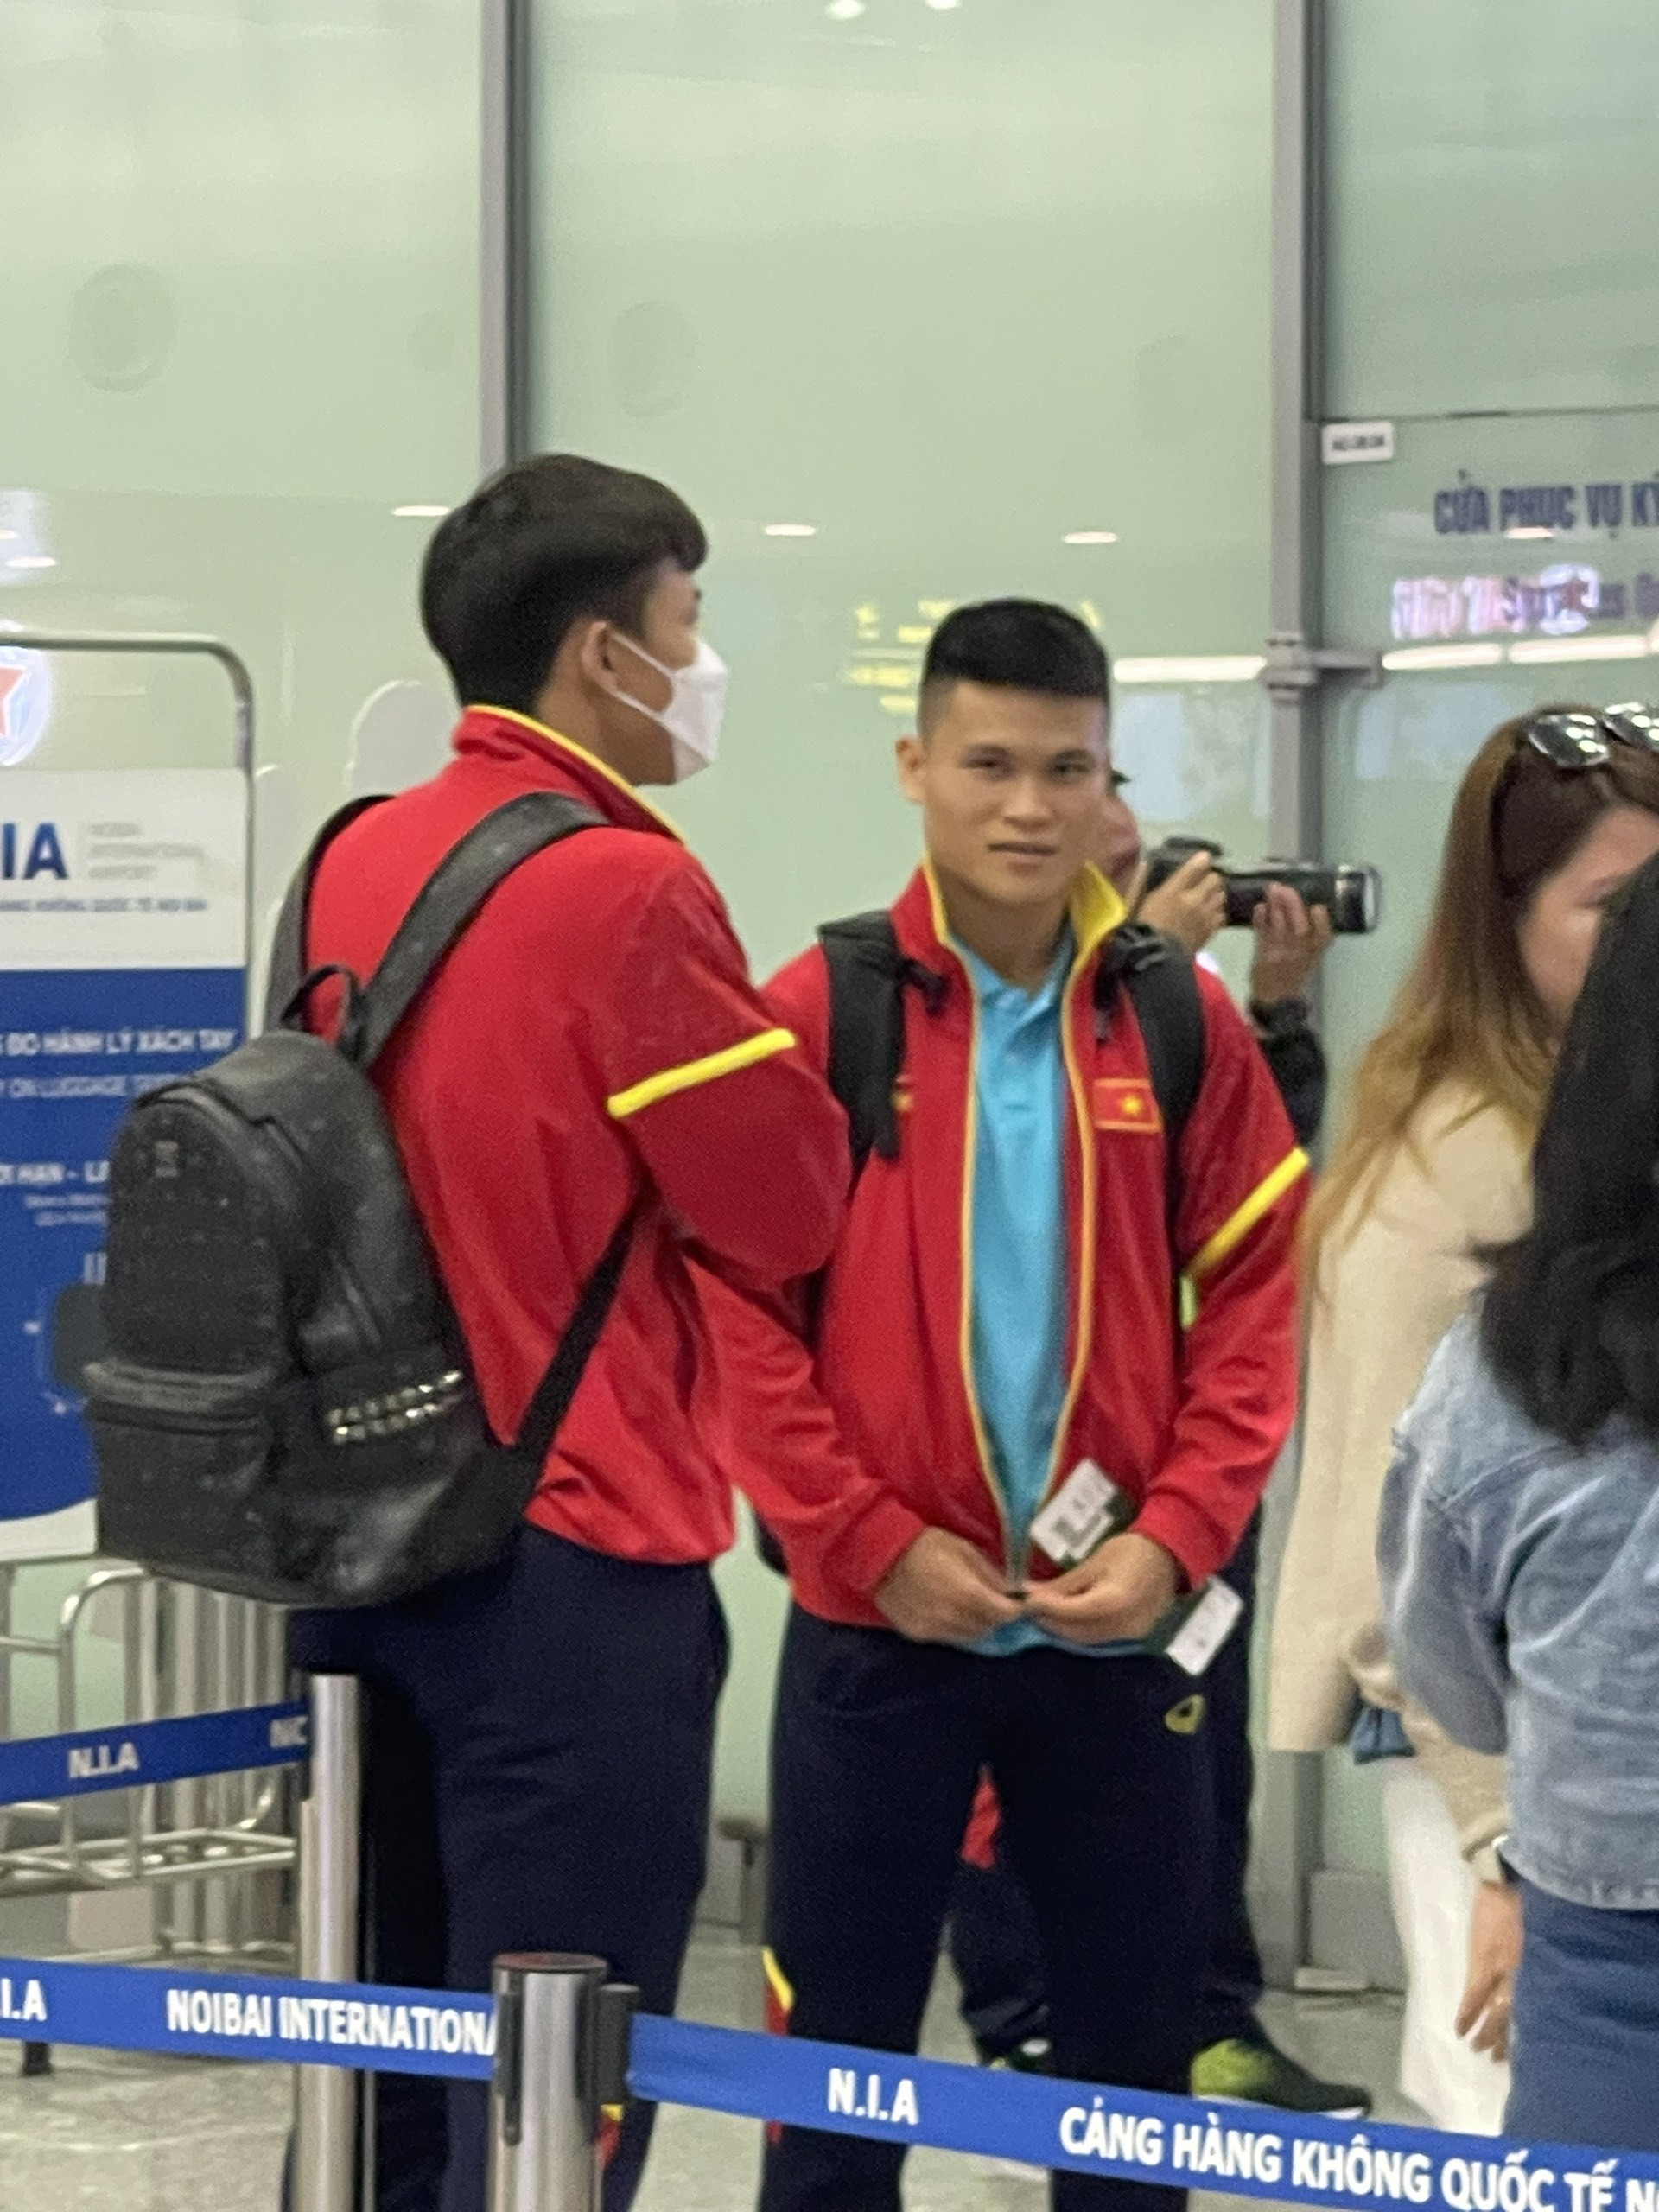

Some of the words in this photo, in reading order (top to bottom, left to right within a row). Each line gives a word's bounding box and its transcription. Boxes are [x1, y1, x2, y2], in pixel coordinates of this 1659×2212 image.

[167, 1989, 272, 2037] NOIBAI
[827, 2068, 918, 2126] N.I.A
[1059, 2095, 1165, 2166] CẢNG
[1173, 2112, 1281, 2183] HÀNG
[1292, 2133, 1432, 2203] KHÔNG
[1441, 2149, 1555, 2212] QUỐC
[1562, 2158, 1619, 2212] TẾ
